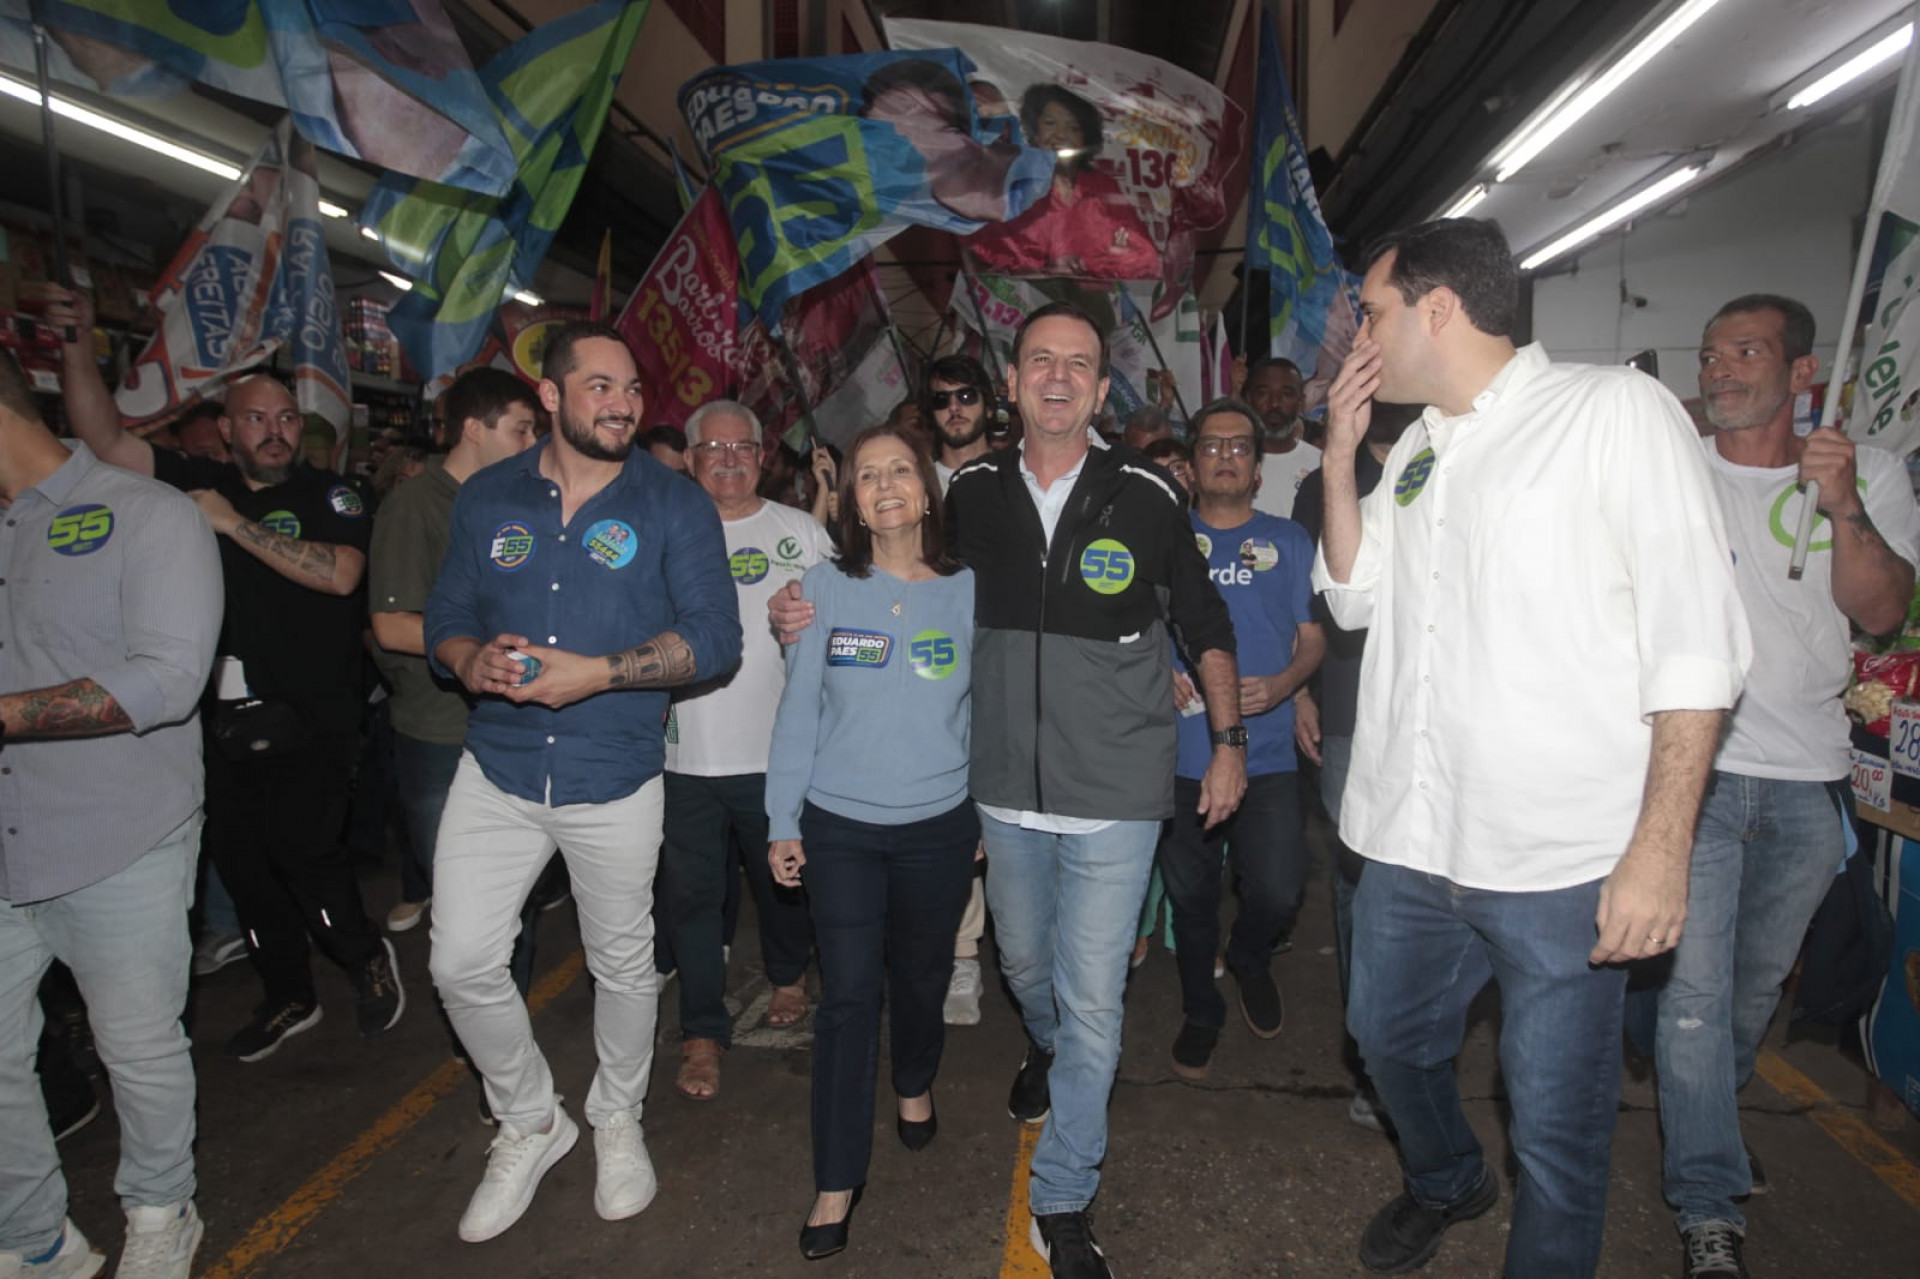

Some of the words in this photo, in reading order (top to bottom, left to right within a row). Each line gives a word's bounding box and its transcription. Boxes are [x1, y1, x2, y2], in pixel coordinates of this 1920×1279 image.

[637, 287, 713, 407] 13513
[1394, 456, 1435, 495] 55
[48, 508, 112, 548] 55
[730, 554, 768, 577] 55
[1081, 549, 1132, 581] 55
[1208, 561, 1254, 586] rde
[831, 646, 858, 656] PAES
[858, 648, 880, 661] 55
[832, 636, 885, 649] EDUARDO
[911, 638, 953, 668] 55
